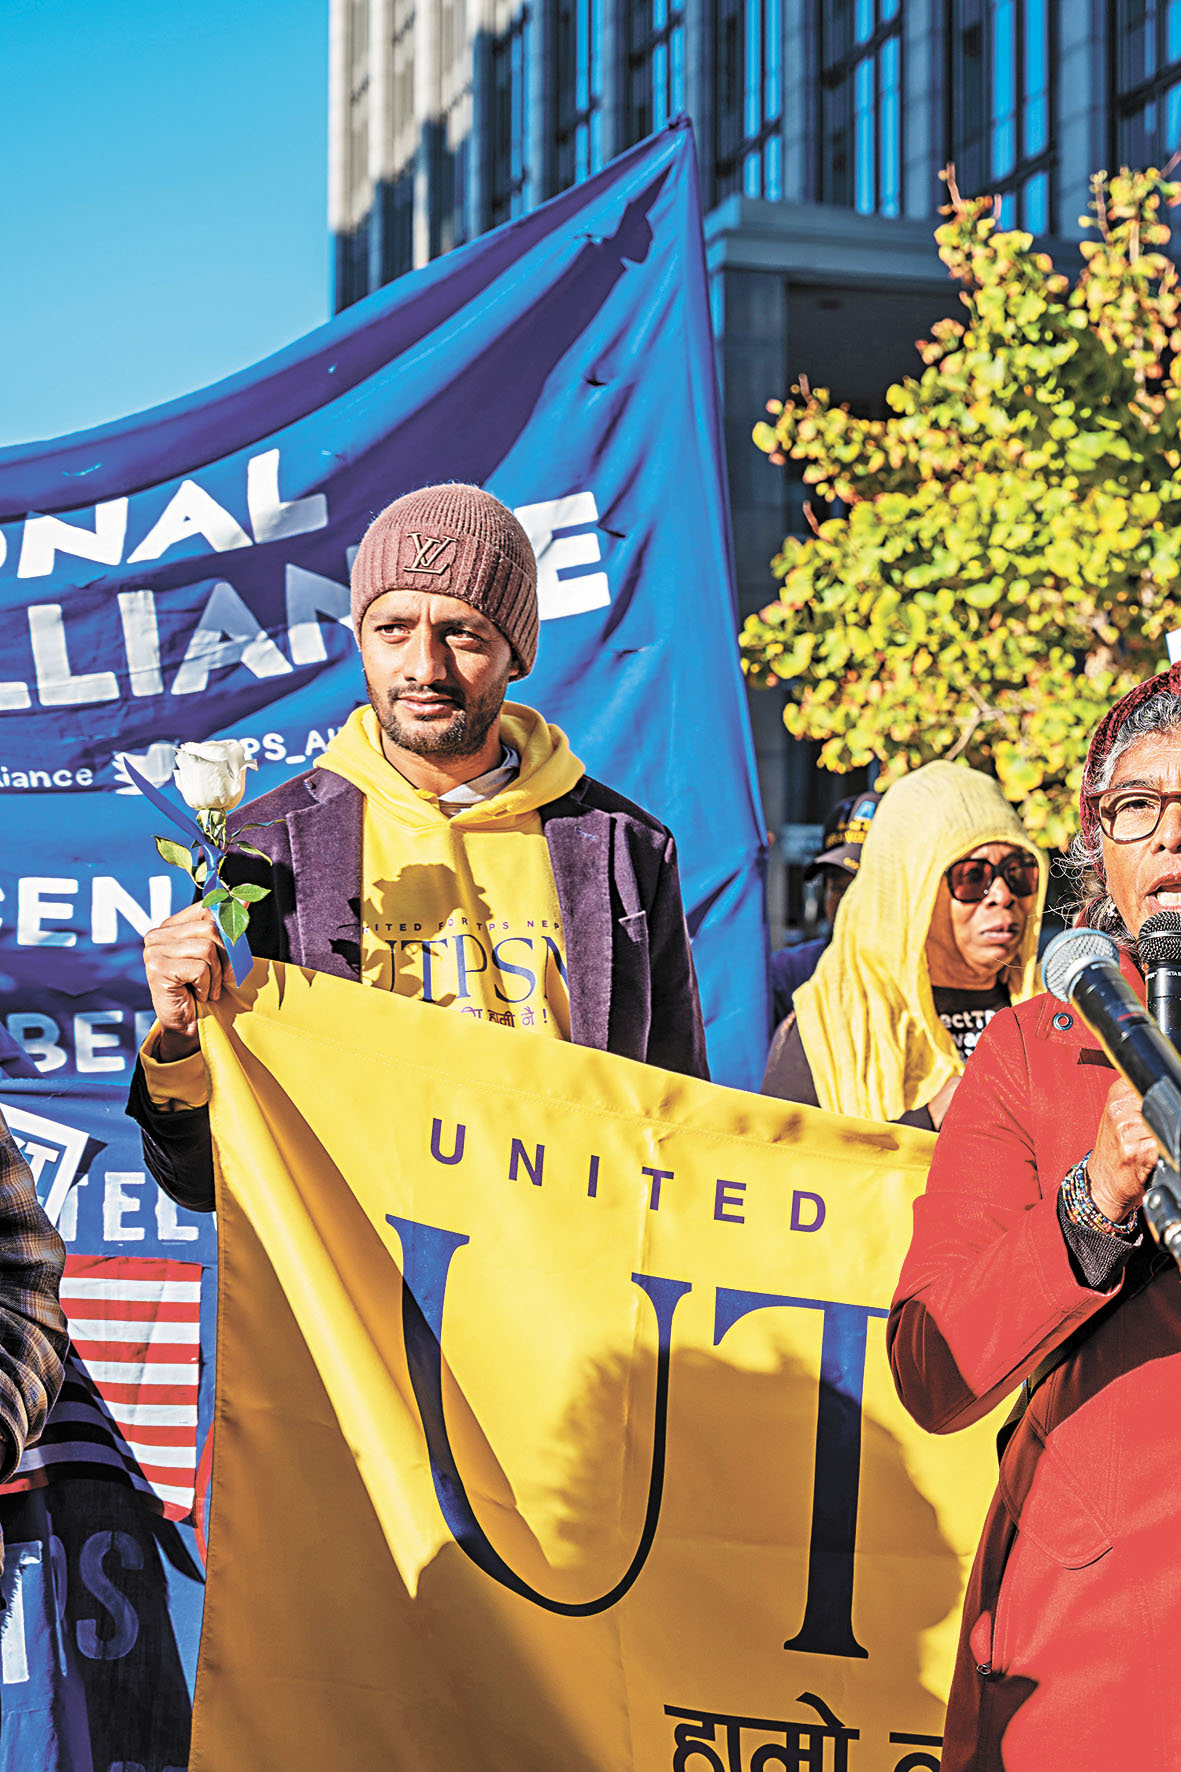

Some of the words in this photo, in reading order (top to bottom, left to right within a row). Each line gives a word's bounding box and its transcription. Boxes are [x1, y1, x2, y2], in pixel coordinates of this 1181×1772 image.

[0, 448, 328, 578] NAL
[0, 766, 93, 788] iance
[0, 876, 172, 947] EN
[476, 921, 510, 931] TPS
[6, 1010, 156, 1073] BE
[430, 1117, 827, 1234] UNITED
